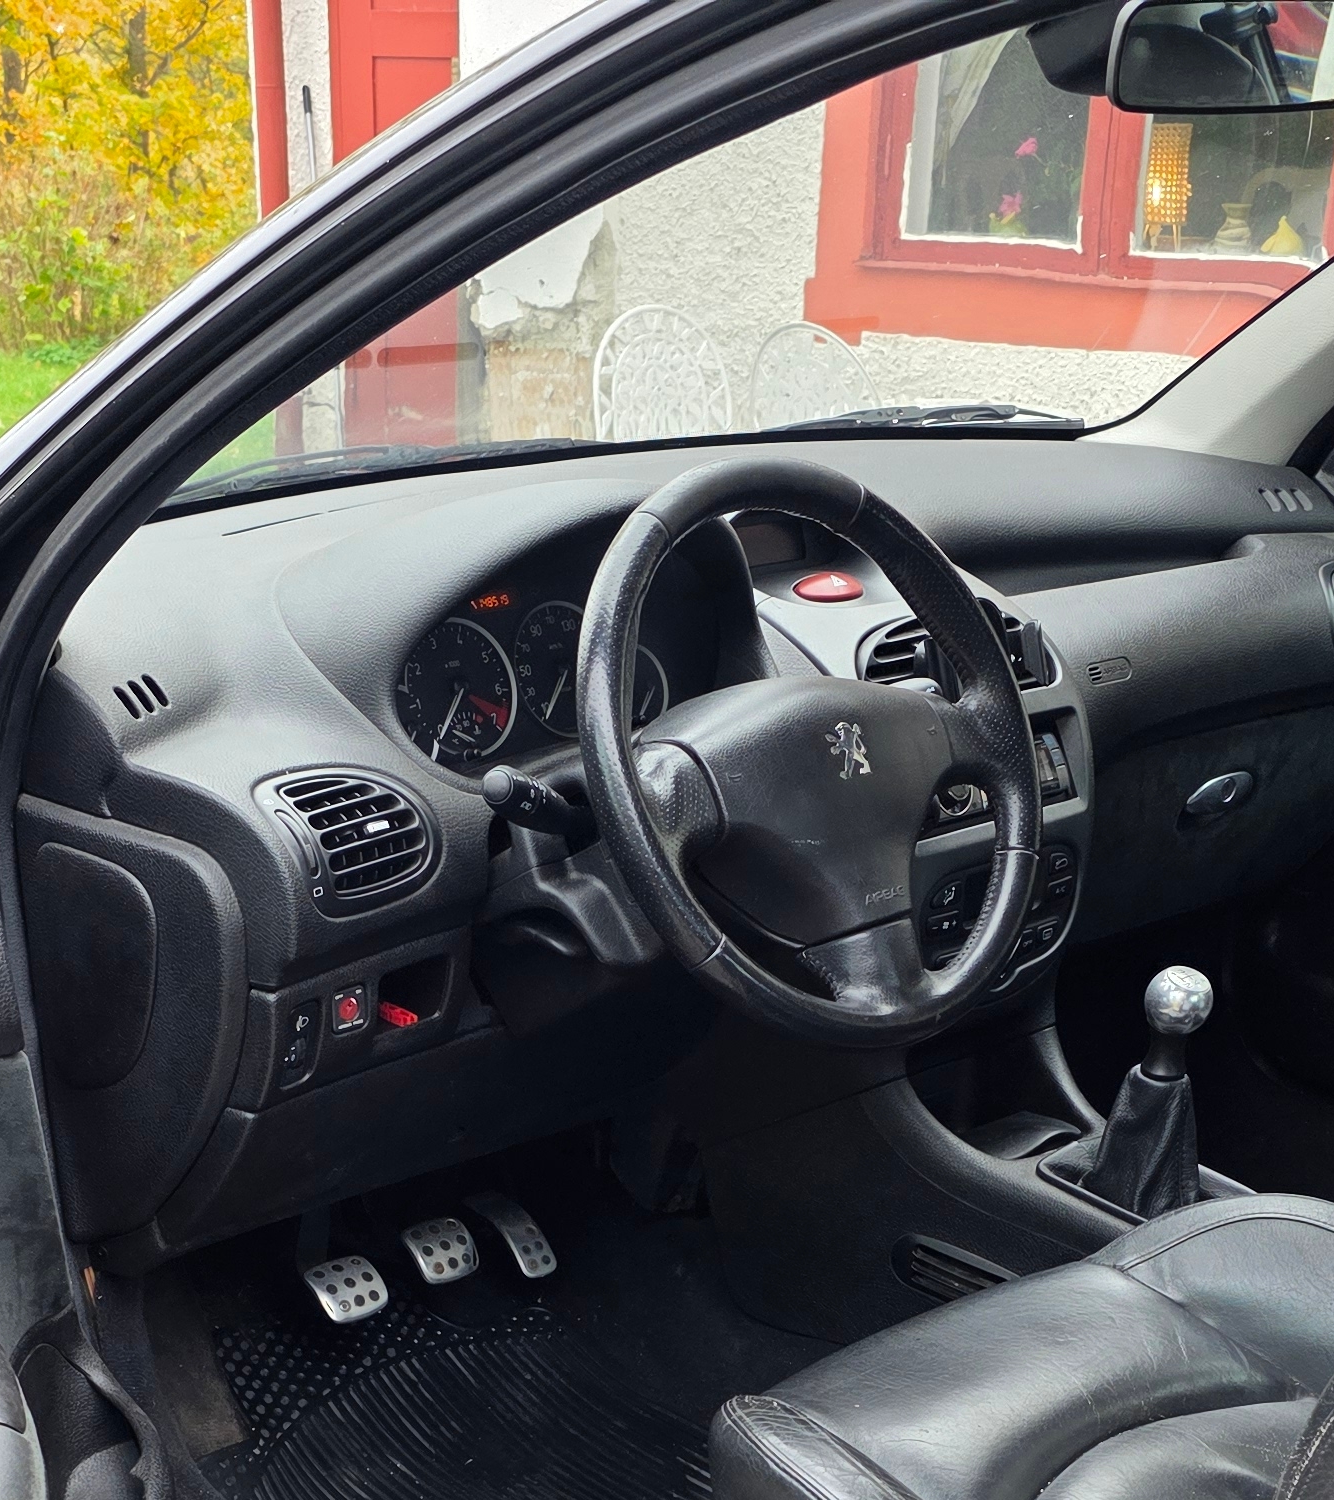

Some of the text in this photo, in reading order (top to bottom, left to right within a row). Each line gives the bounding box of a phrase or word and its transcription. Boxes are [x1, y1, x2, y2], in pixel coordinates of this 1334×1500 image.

[529, 623, 543, 637] 90
[429, 637, 437, 650] 3
[456, 633, 463, 645] 4
[481, 651, 489, 664] 5
[414, 662, 422, 676] 2
[518, 664, 532, 678] 50
[494, 683, 503, 696] 6
